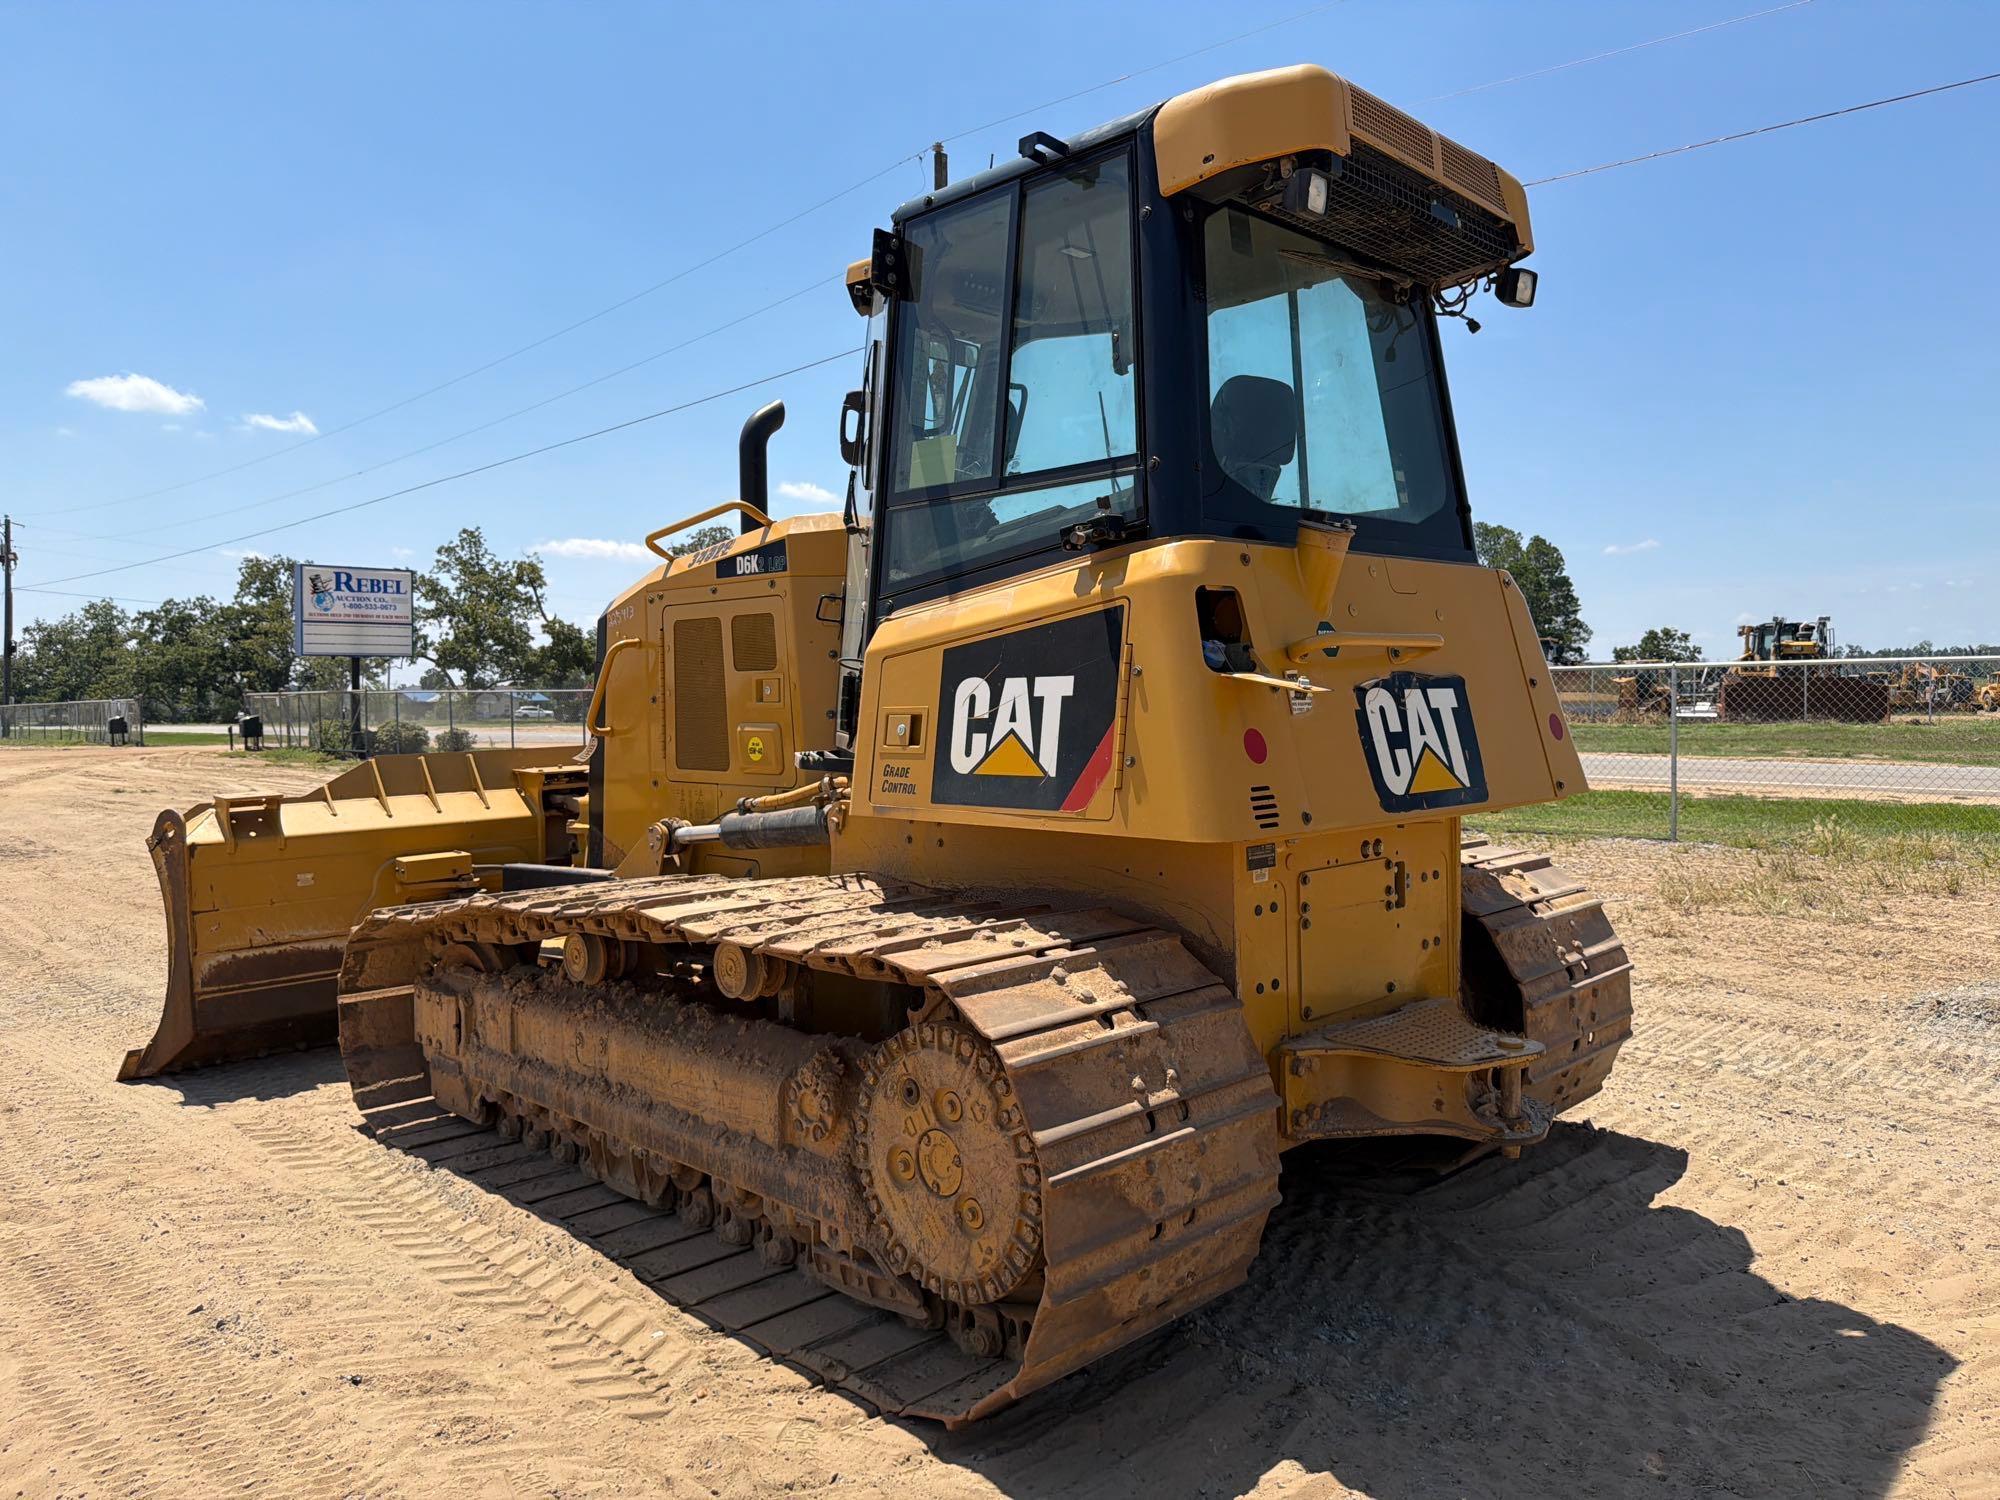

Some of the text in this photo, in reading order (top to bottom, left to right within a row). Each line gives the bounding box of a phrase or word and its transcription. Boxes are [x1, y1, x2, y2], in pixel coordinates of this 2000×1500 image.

[333, 572, 408, 594] REBEL
[343, 603, 397, 611] 1-800-533-0673
[950, 675, 1075, 778] CAT
[1365, 687, 1471, 796] CAT
[883, 763, 911, 778] GRADE
[881, 779, 917, 794] CONTROL
